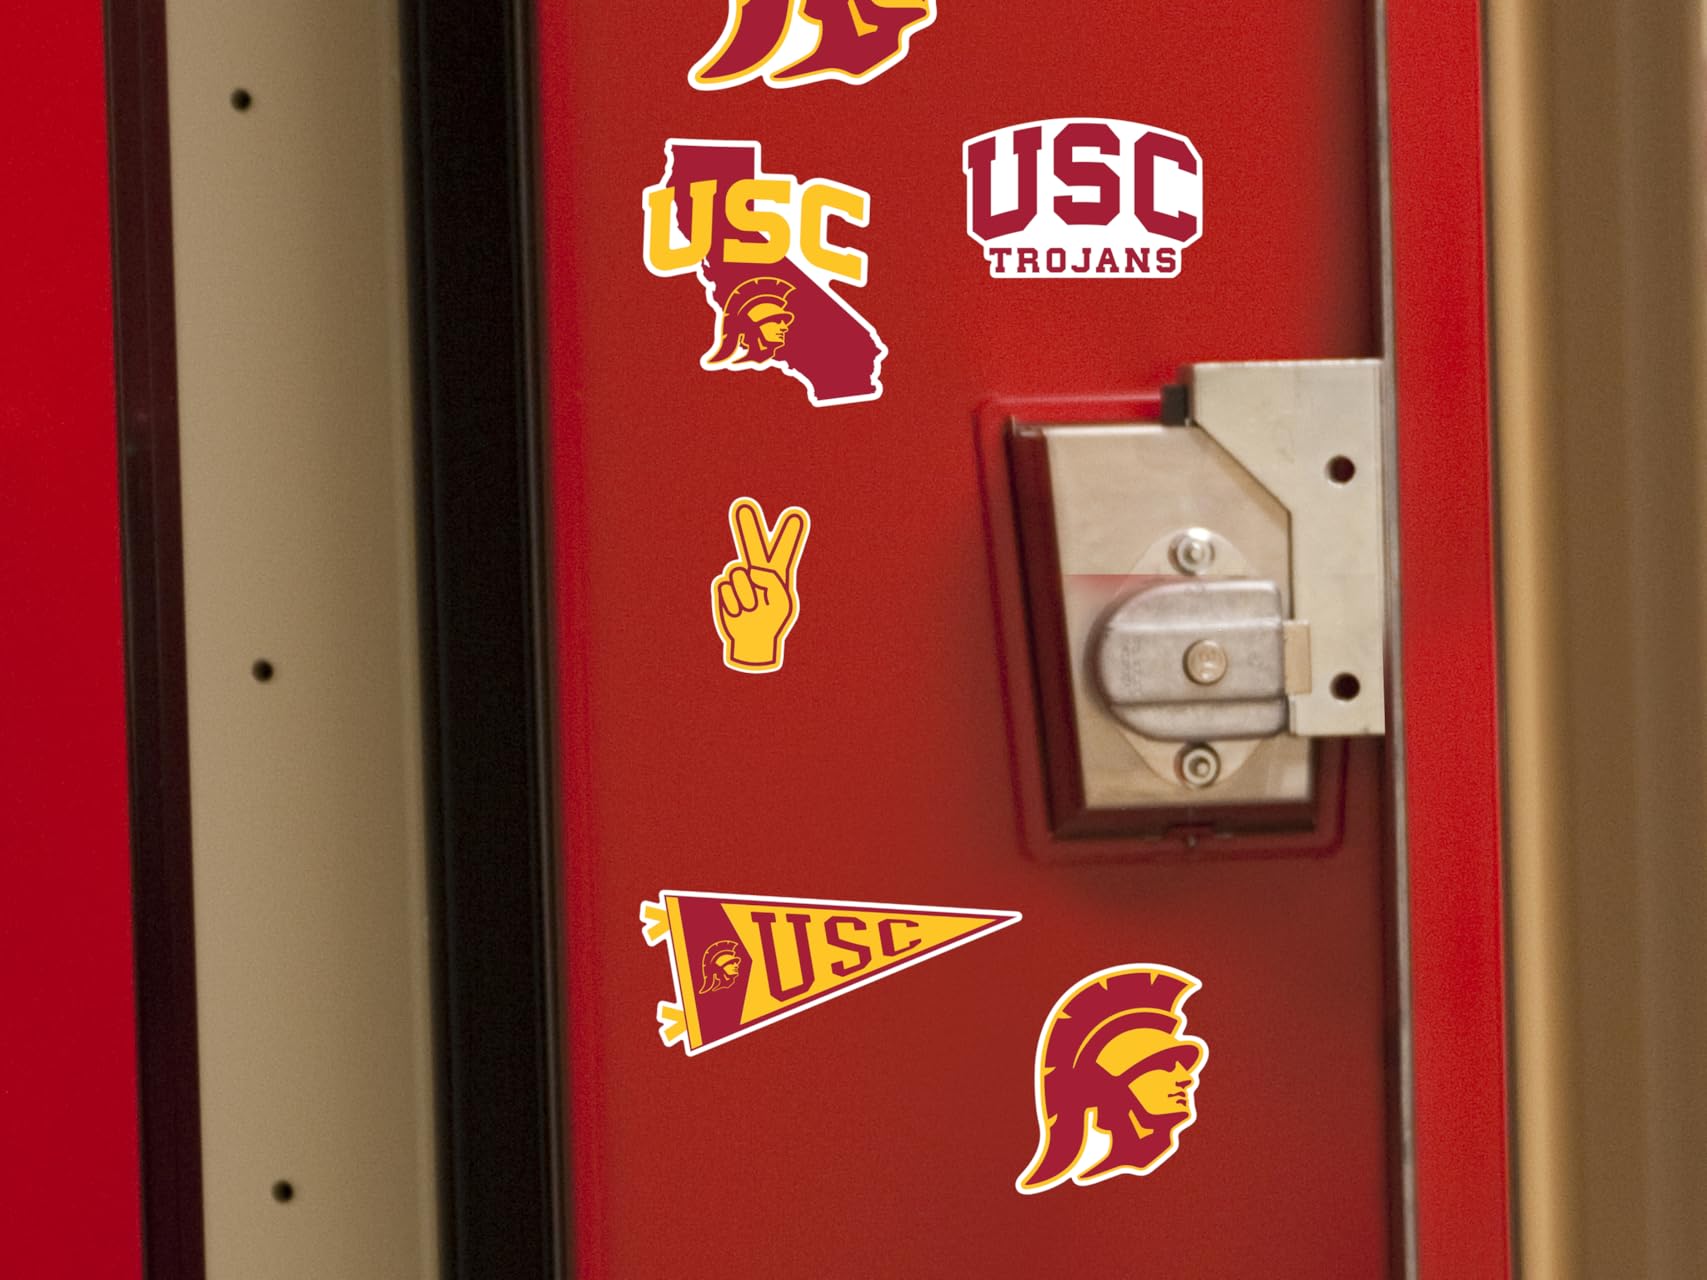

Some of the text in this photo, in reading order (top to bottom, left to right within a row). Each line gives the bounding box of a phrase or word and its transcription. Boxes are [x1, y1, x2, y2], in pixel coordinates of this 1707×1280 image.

[648, 179, 864, 281] USC
[968, 123, 1197, 242] USC
[989, 247, 1176, 273] TROJANS
[751, 911, 922, 1002] USC
